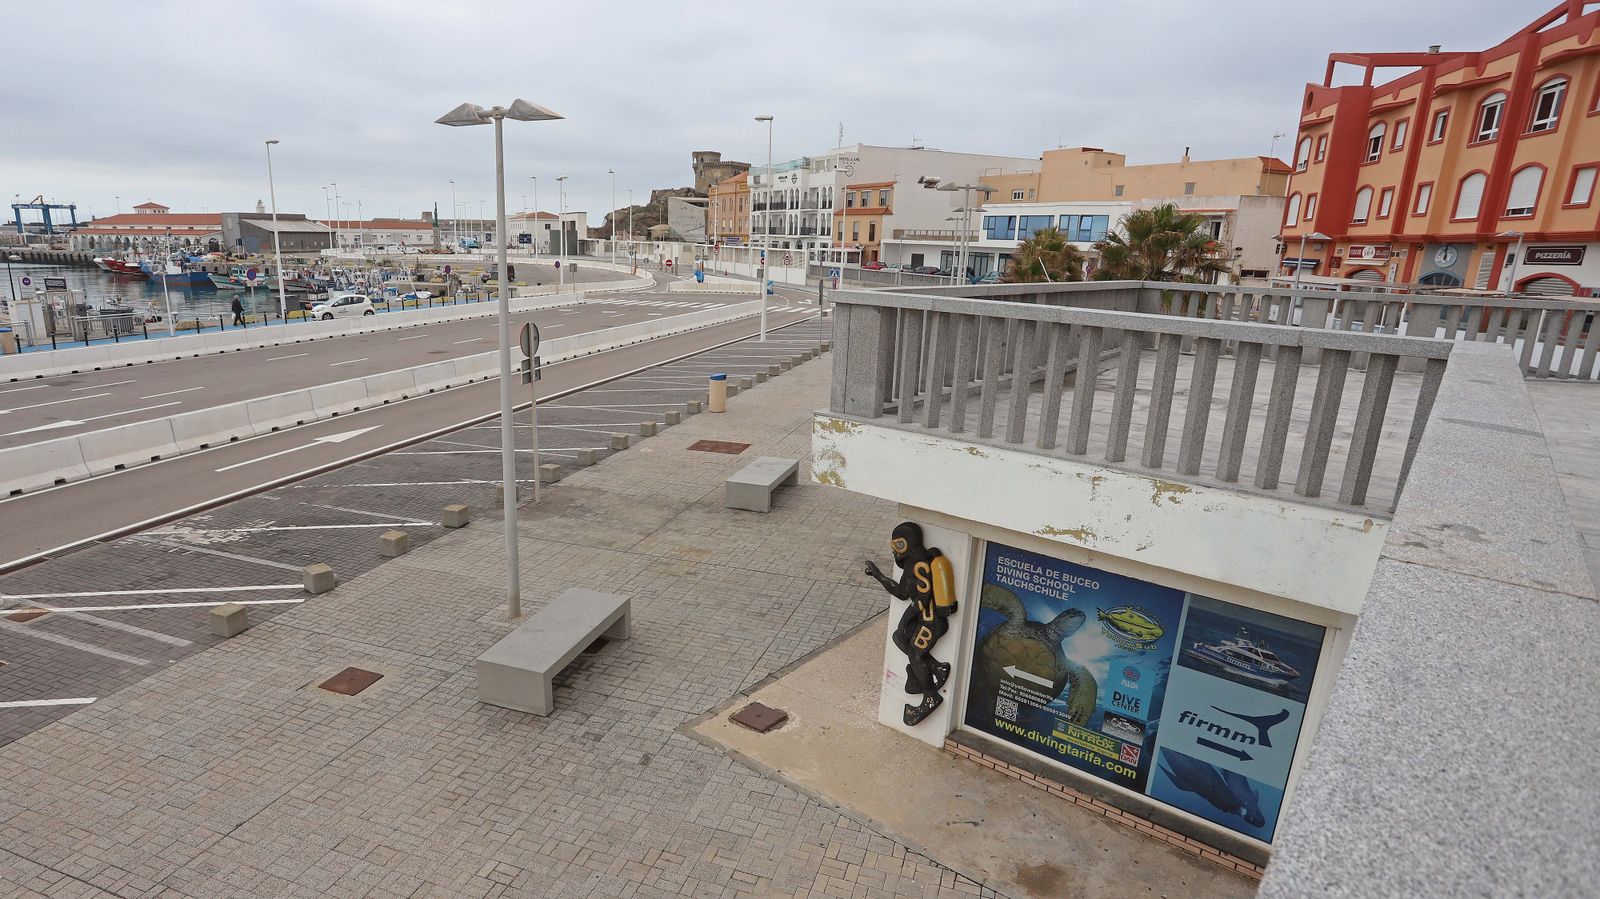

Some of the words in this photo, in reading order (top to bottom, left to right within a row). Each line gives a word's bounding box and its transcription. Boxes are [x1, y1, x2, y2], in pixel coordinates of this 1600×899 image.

[1535, 250, 1571, 259] PIZZERÍA
[996, 565, 1031, 581] DIVING
[1032, 575, 1076, 594] SCHOOL
[997, 556, 1043, 575] ESCUELA
[1045, 568, 1060, 579] DE
[1062, 572, 1100, 590] BUCEO
[996, 574, 1069, 601] TAUCHSCHULE
[1111, 700, 1140, 714] CENTER
[1113, 690, 1141, 709] DIVE
[1177, 710, 1257, 745] firmm
[994, 718, 1137, 780] www.divingtarifa.com
[1067, 729, 1116, 751] NITROX
[1120, 754, 1137, 765] DAN
